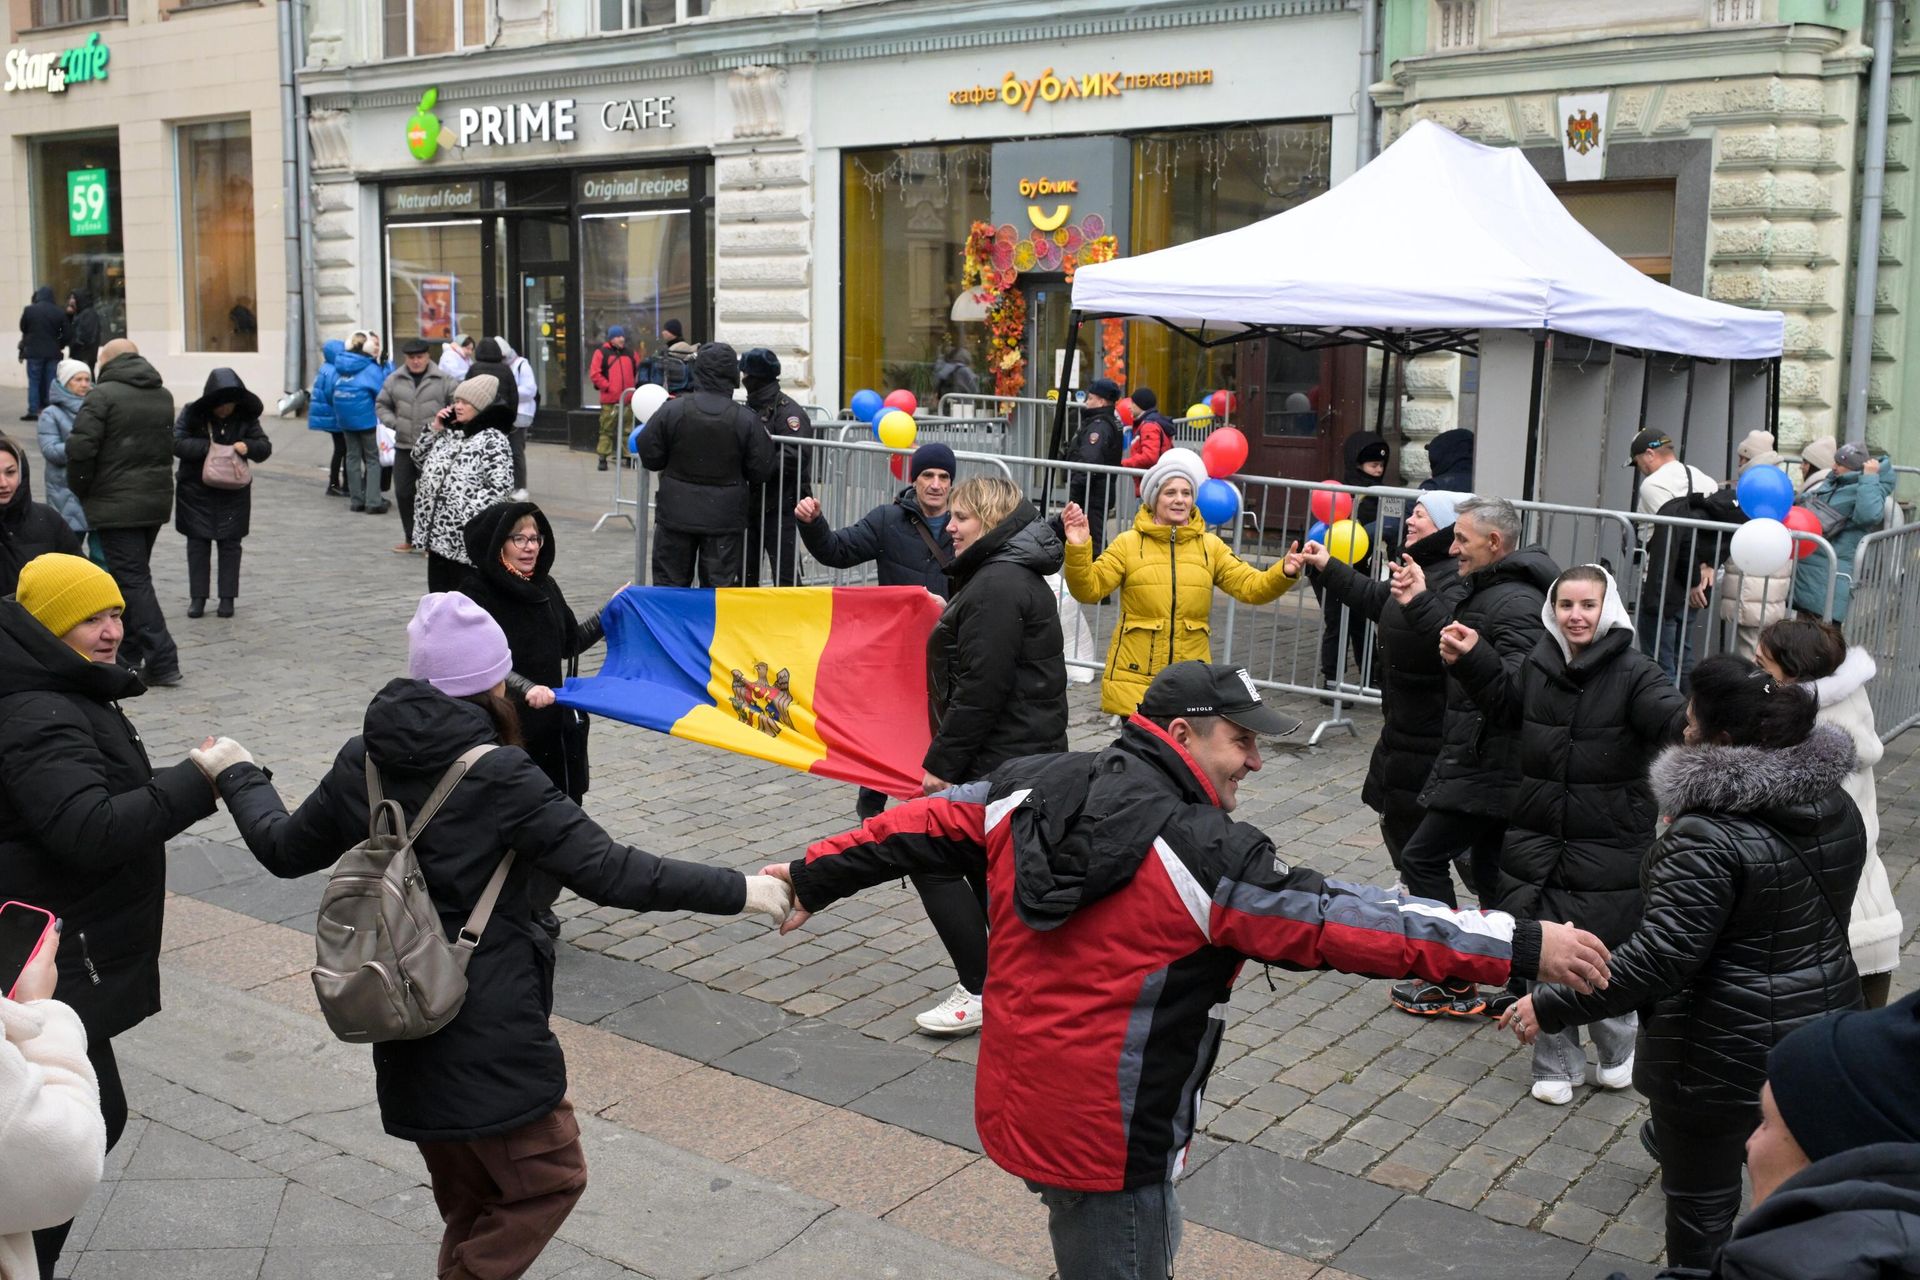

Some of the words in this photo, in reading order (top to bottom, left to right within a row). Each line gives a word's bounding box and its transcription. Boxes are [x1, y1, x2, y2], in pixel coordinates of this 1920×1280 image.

[4, 47, 56, 92] Star
[60, 31, 109, 84] cafe
[948, 85, 998, 107] кафе
[1000, 67, 1122, 113] бублик
[1123, 68, 1214, 90] пекарня
[459, 99, 576, 148] PRIME
[600, 96, 676, 132] CAFE
[72, 183, 105, 221] 59
[397, 189, 443, 209] Natural
[444, 188, 473, 207] food
[584, 177, 639, 201] Original
[640, 175, 689, 197] recipes
[1019, 176, 1079, 199] бублик
